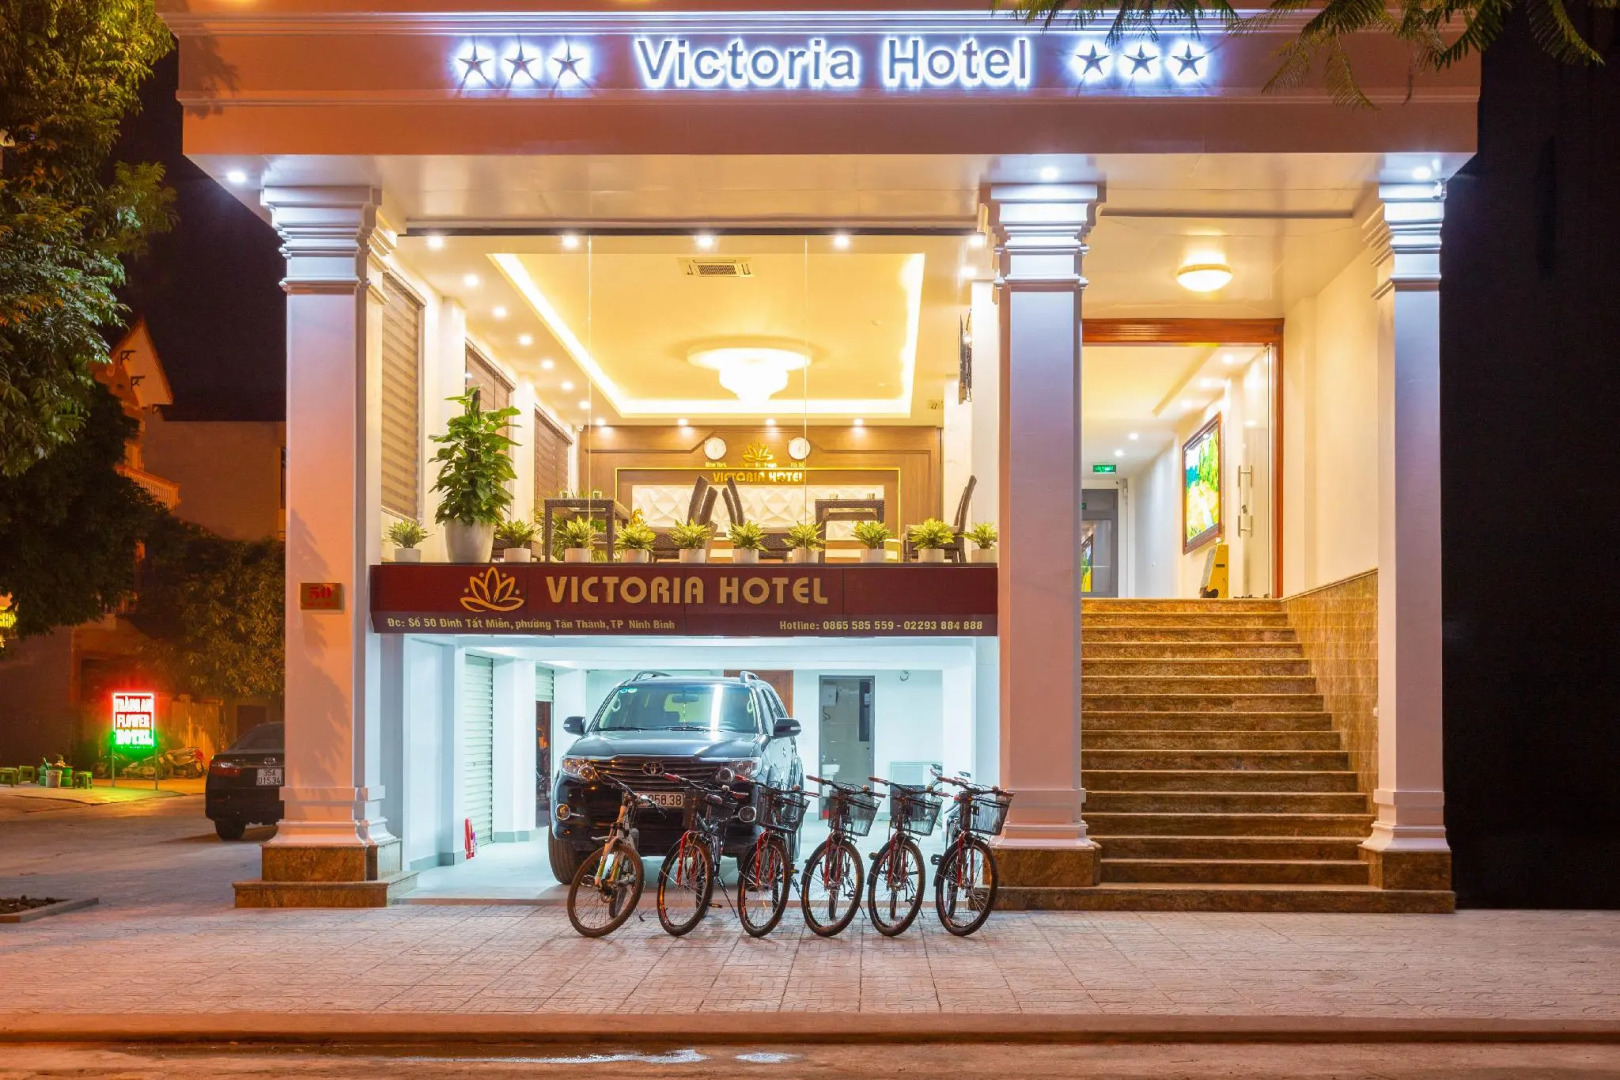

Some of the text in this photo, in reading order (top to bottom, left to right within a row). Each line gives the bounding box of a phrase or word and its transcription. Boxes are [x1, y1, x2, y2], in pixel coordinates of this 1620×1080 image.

[636, 38, 1028, 82] Victoria Hotel
[713, 471, 765, 482] VICTORIA
[545, 576, 829, 605] VICTORIA HOTEL
[387, 617, 405, 627] Đc:
[408, 616, 421, 627] Số
[423, 618, 437, 627] 50
[440, 618, 462, 628] Đinh
[465, 617, 483, 628] Tất
[629, 620, 651, 629] Ninh
[780, 620, 819, 630] Hotline:
[823, 621, 849, 630] 0865
[852, 621, 871, 630] 585
[874, 621, 894, 630] 559
[903, 621, 937, 630] 02293
[940, 621, 960, 630] 884
[963, 621, 983, 630] 888
